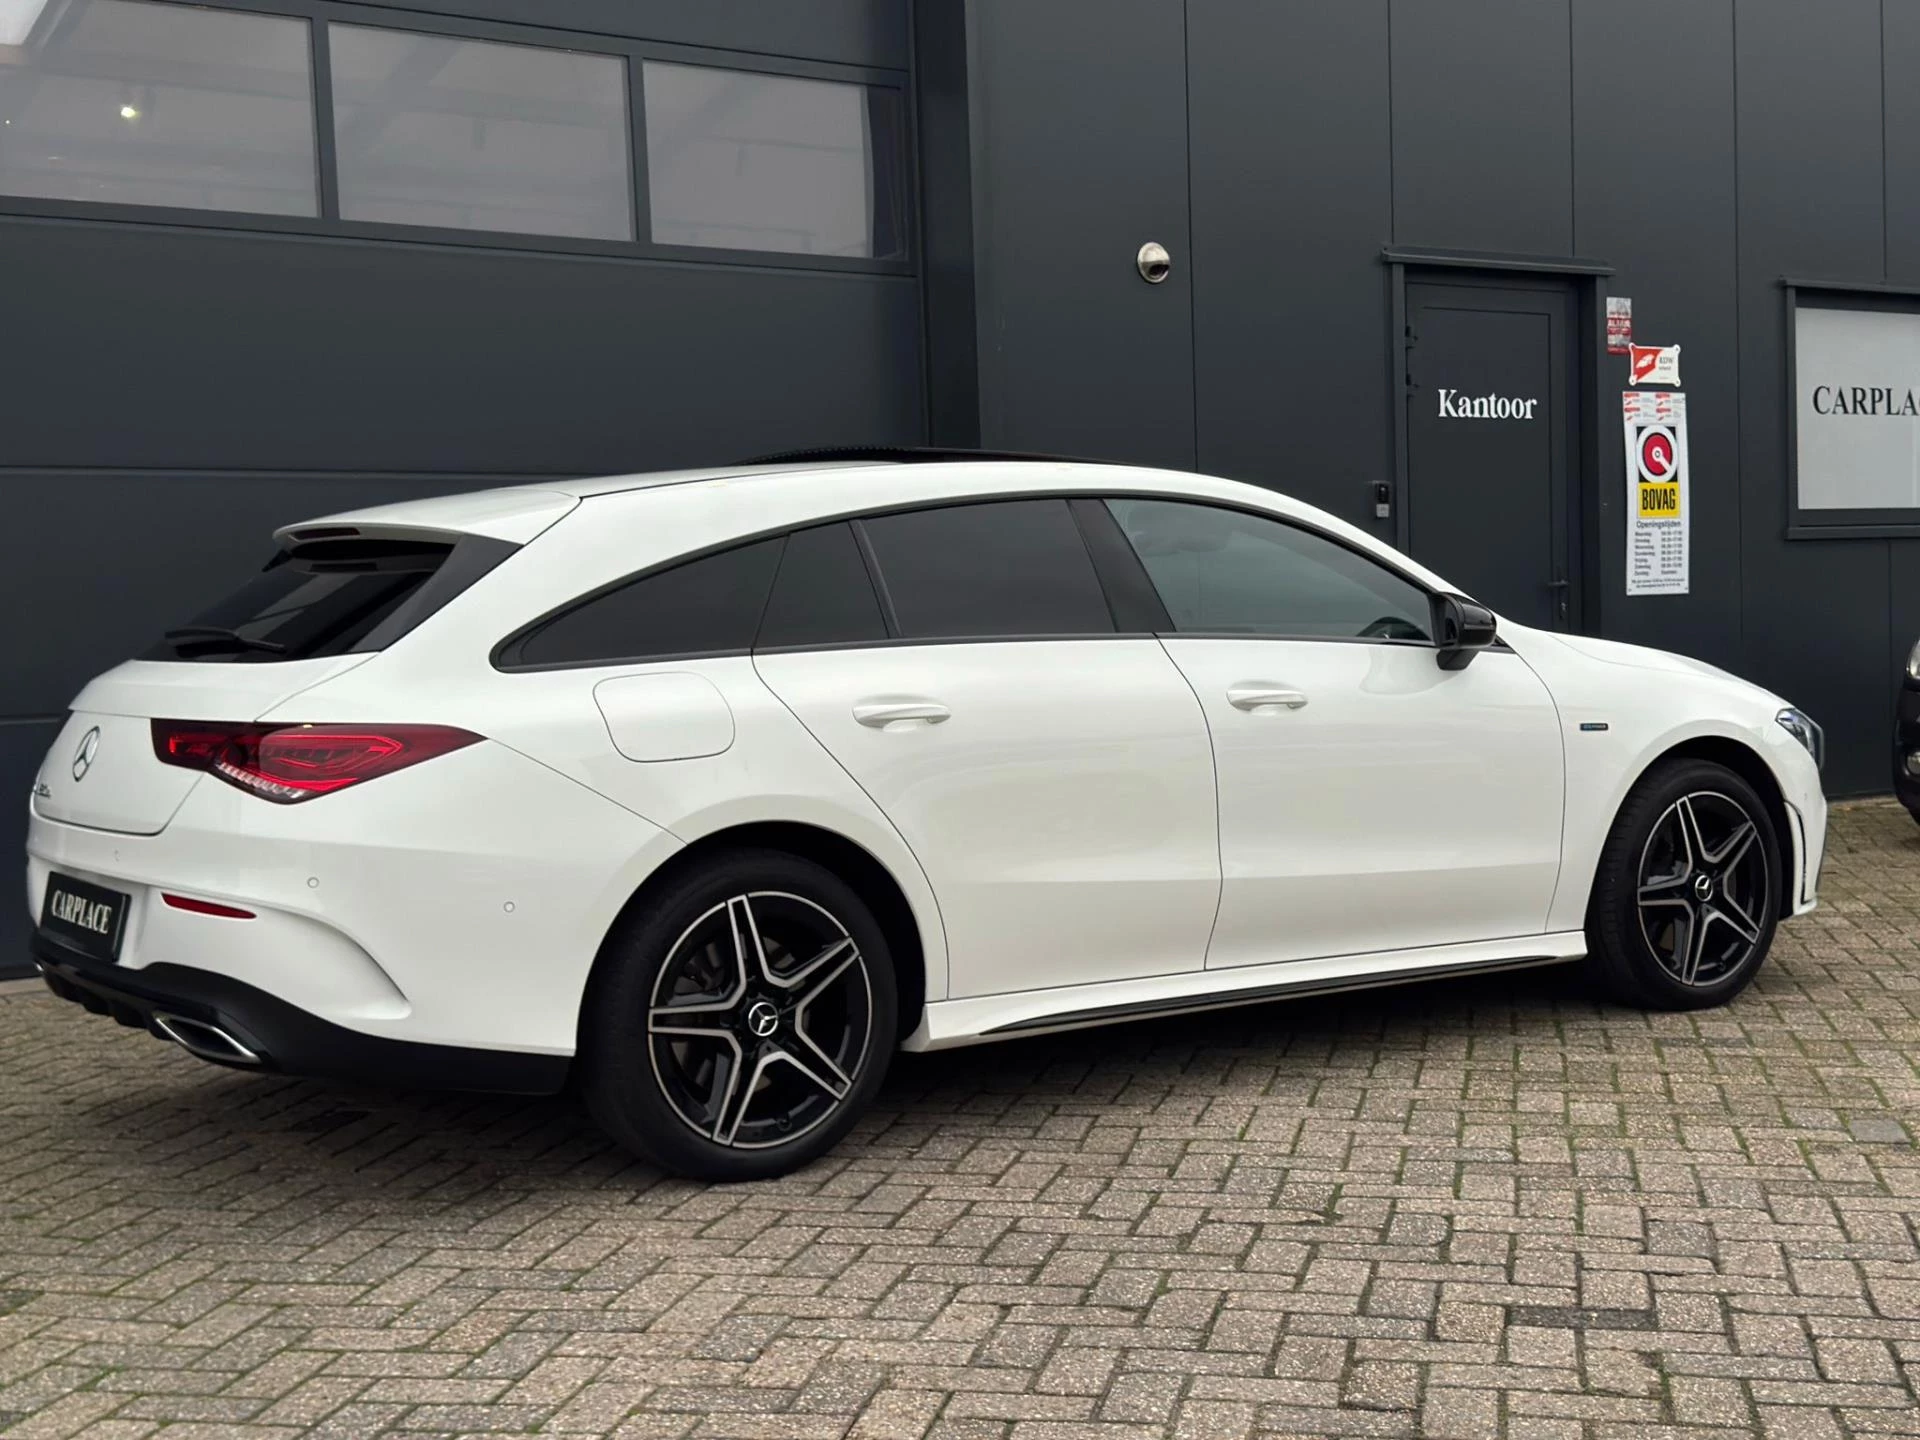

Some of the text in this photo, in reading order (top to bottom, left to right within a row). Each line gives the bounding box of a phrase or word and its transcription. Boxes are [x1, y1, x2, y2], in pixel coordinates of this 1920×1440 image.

[1438, 389, 1538, 419] Kantoor
[1813, 385, 1920, 416] CARPLA
[1642, 488, 1676, 511] BOVAG
[52, 889, 112, 934] CARPLACE
